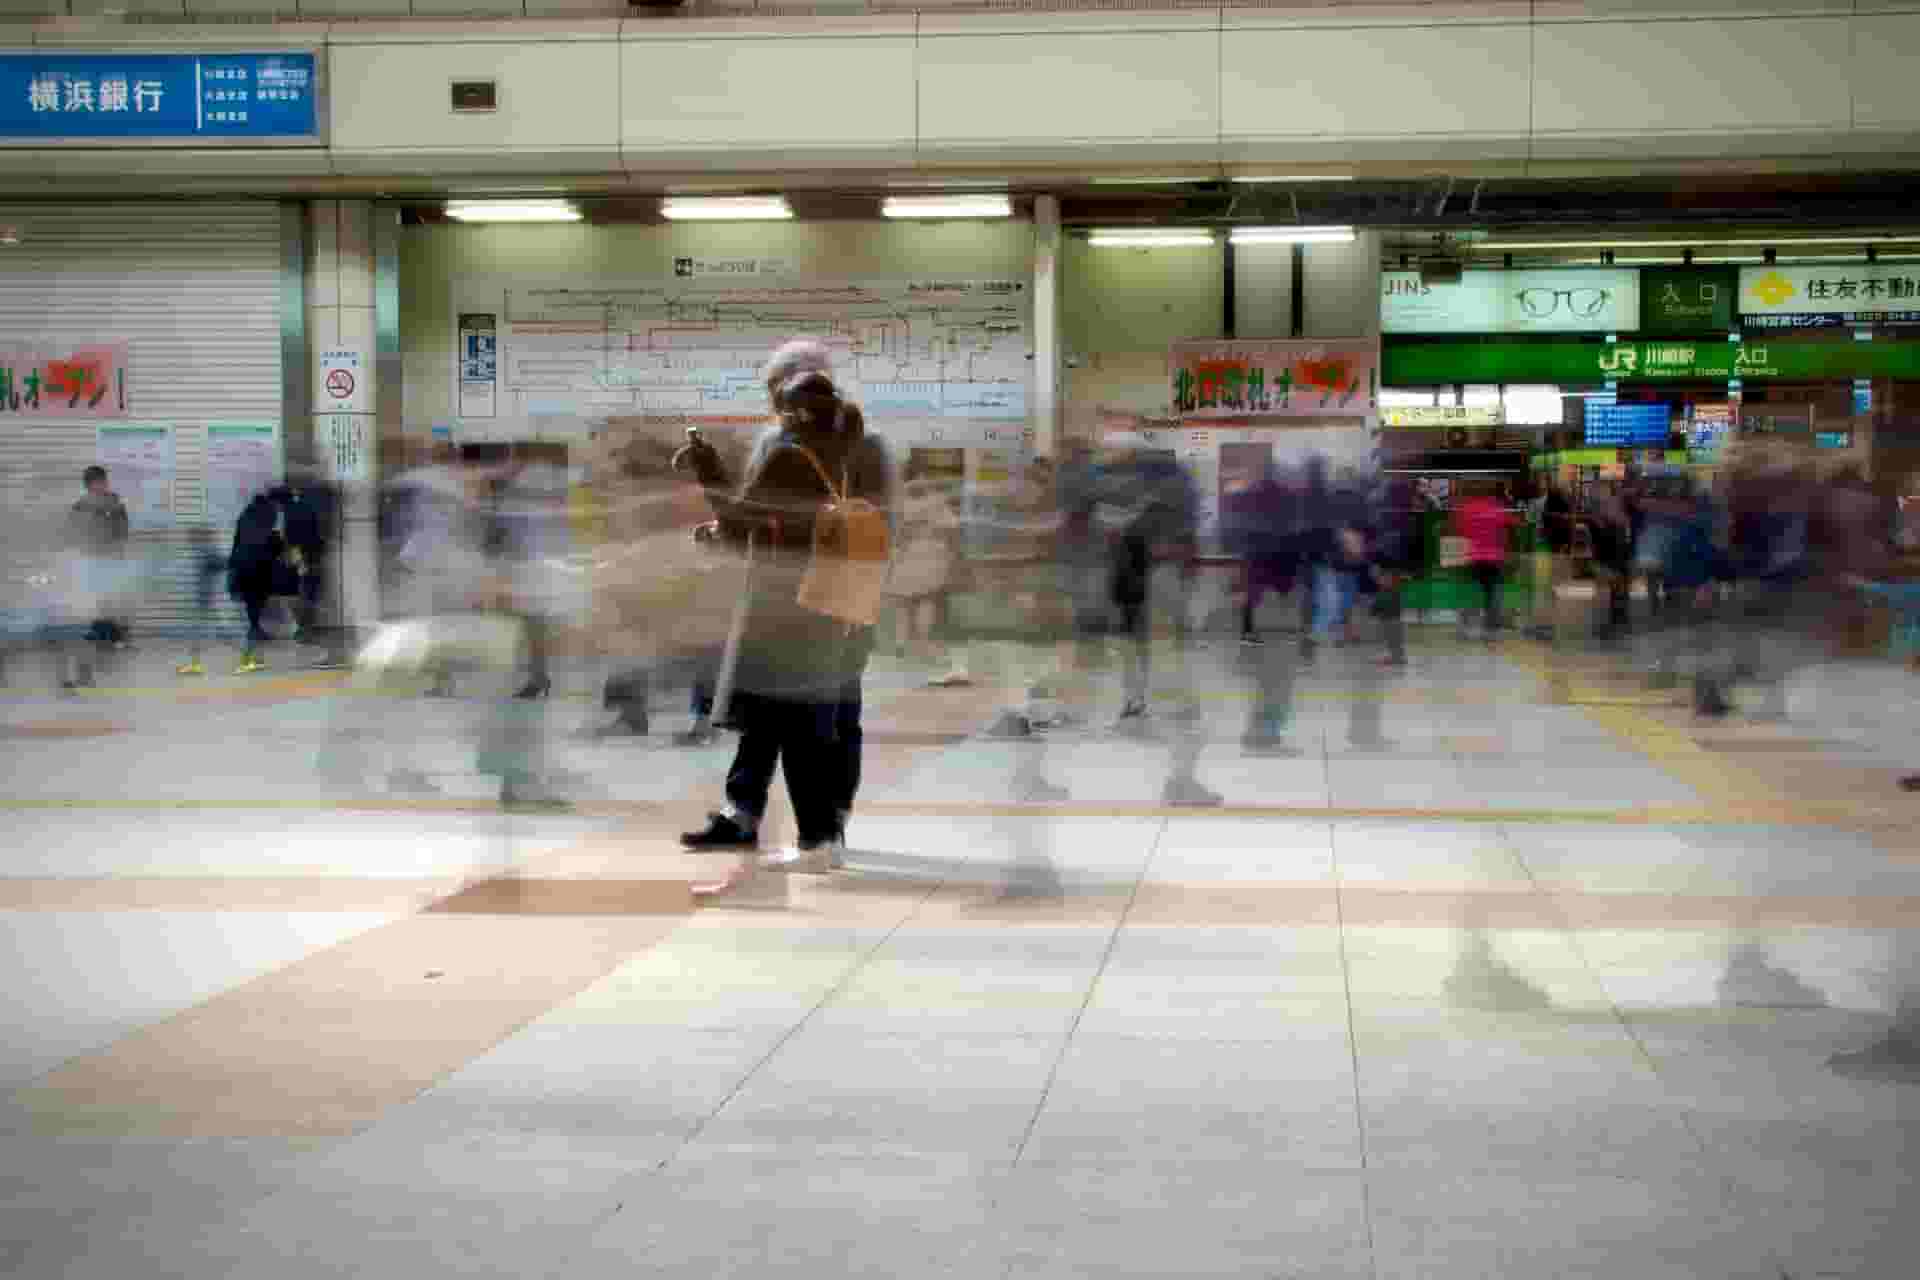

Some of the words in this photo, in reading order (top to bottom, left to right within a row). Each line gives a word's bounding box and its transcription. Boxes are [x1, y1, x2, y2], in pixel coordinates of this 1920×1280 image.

[28, 80, 163, 112] 横浜銀行
[1383, 279, 1431, 296] JINS
[1660, 281, 1718, 304] 入口
[1808, 276, 1920, 299] 住友不動
[1599, 345, 1637, 370] JR
[1735, 344, 1768, 364] 入口
